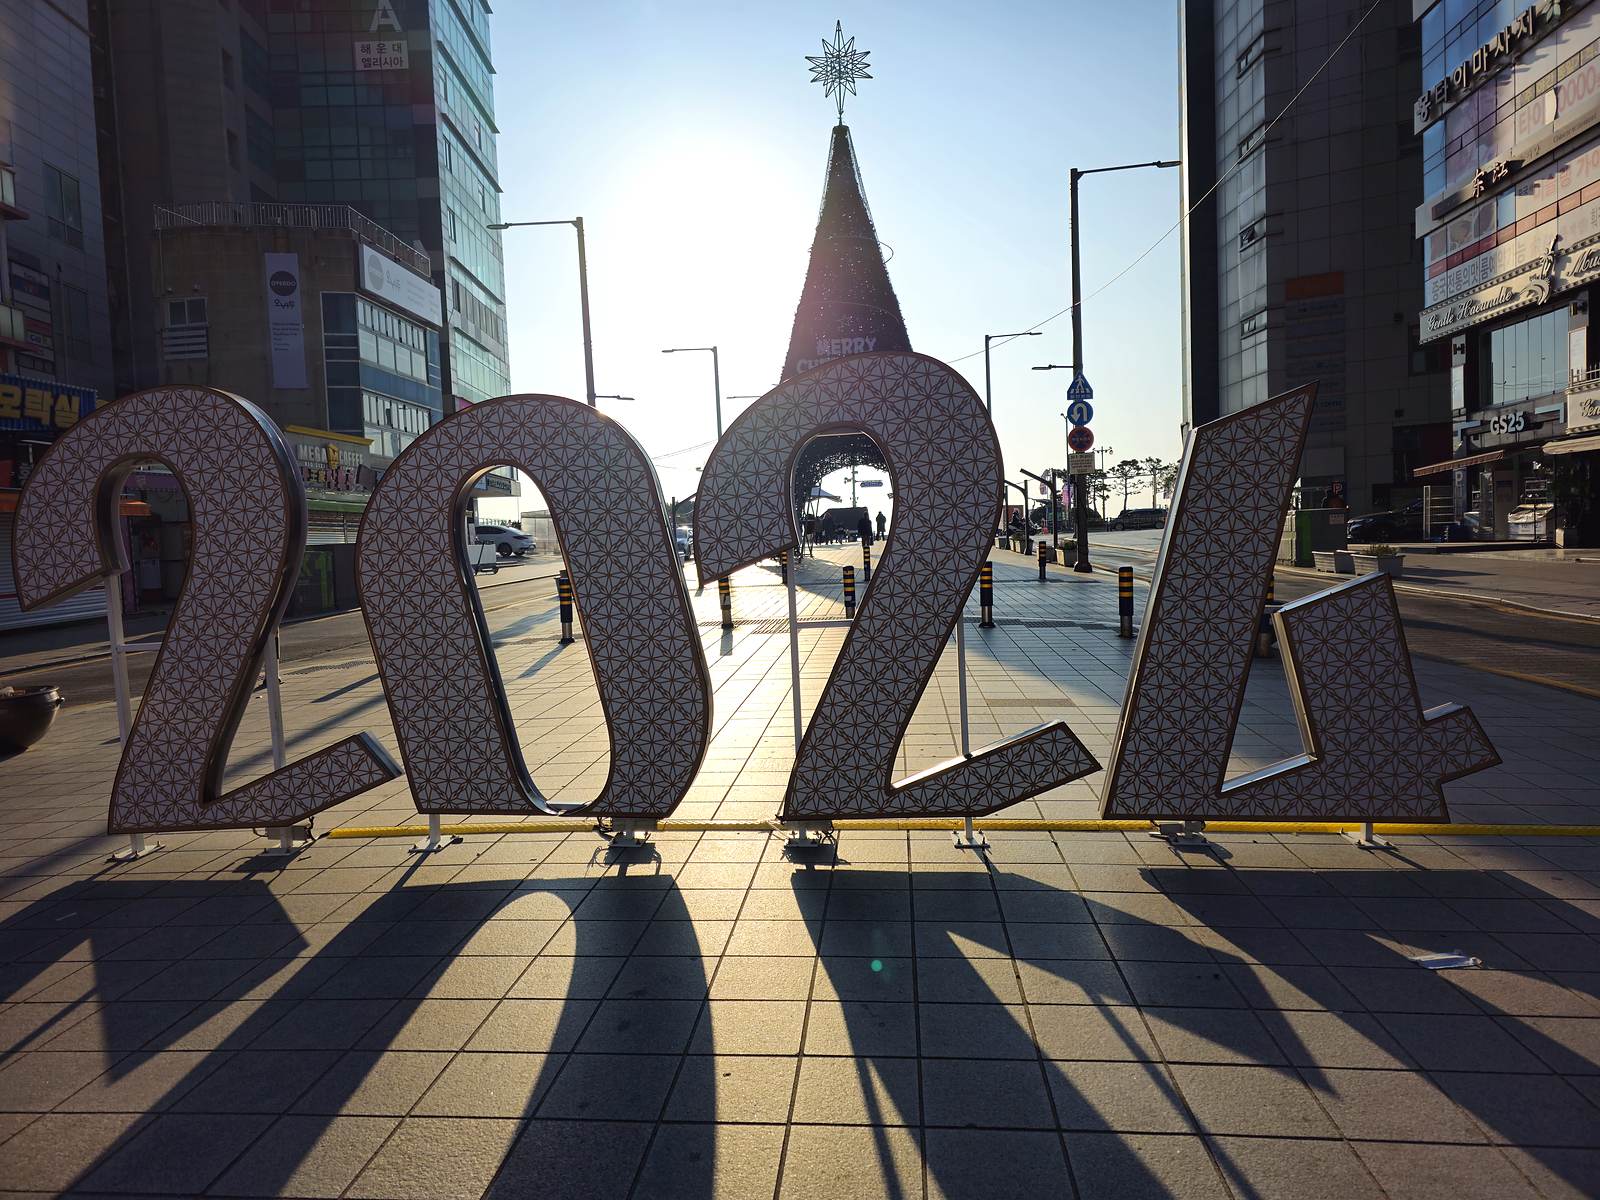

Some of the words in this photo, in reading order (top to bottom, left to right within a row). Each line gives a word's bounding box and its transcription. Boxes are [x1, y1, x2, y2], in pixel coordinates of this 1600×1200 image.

[360, 42, 402, 54] 해운대
[816, 337, 877, 356] MERRY
[1489, 411, 1525, 435] GS25
[298, 444, 327, 464] MEGA
[339, 449, 364, 466] COFFEE
